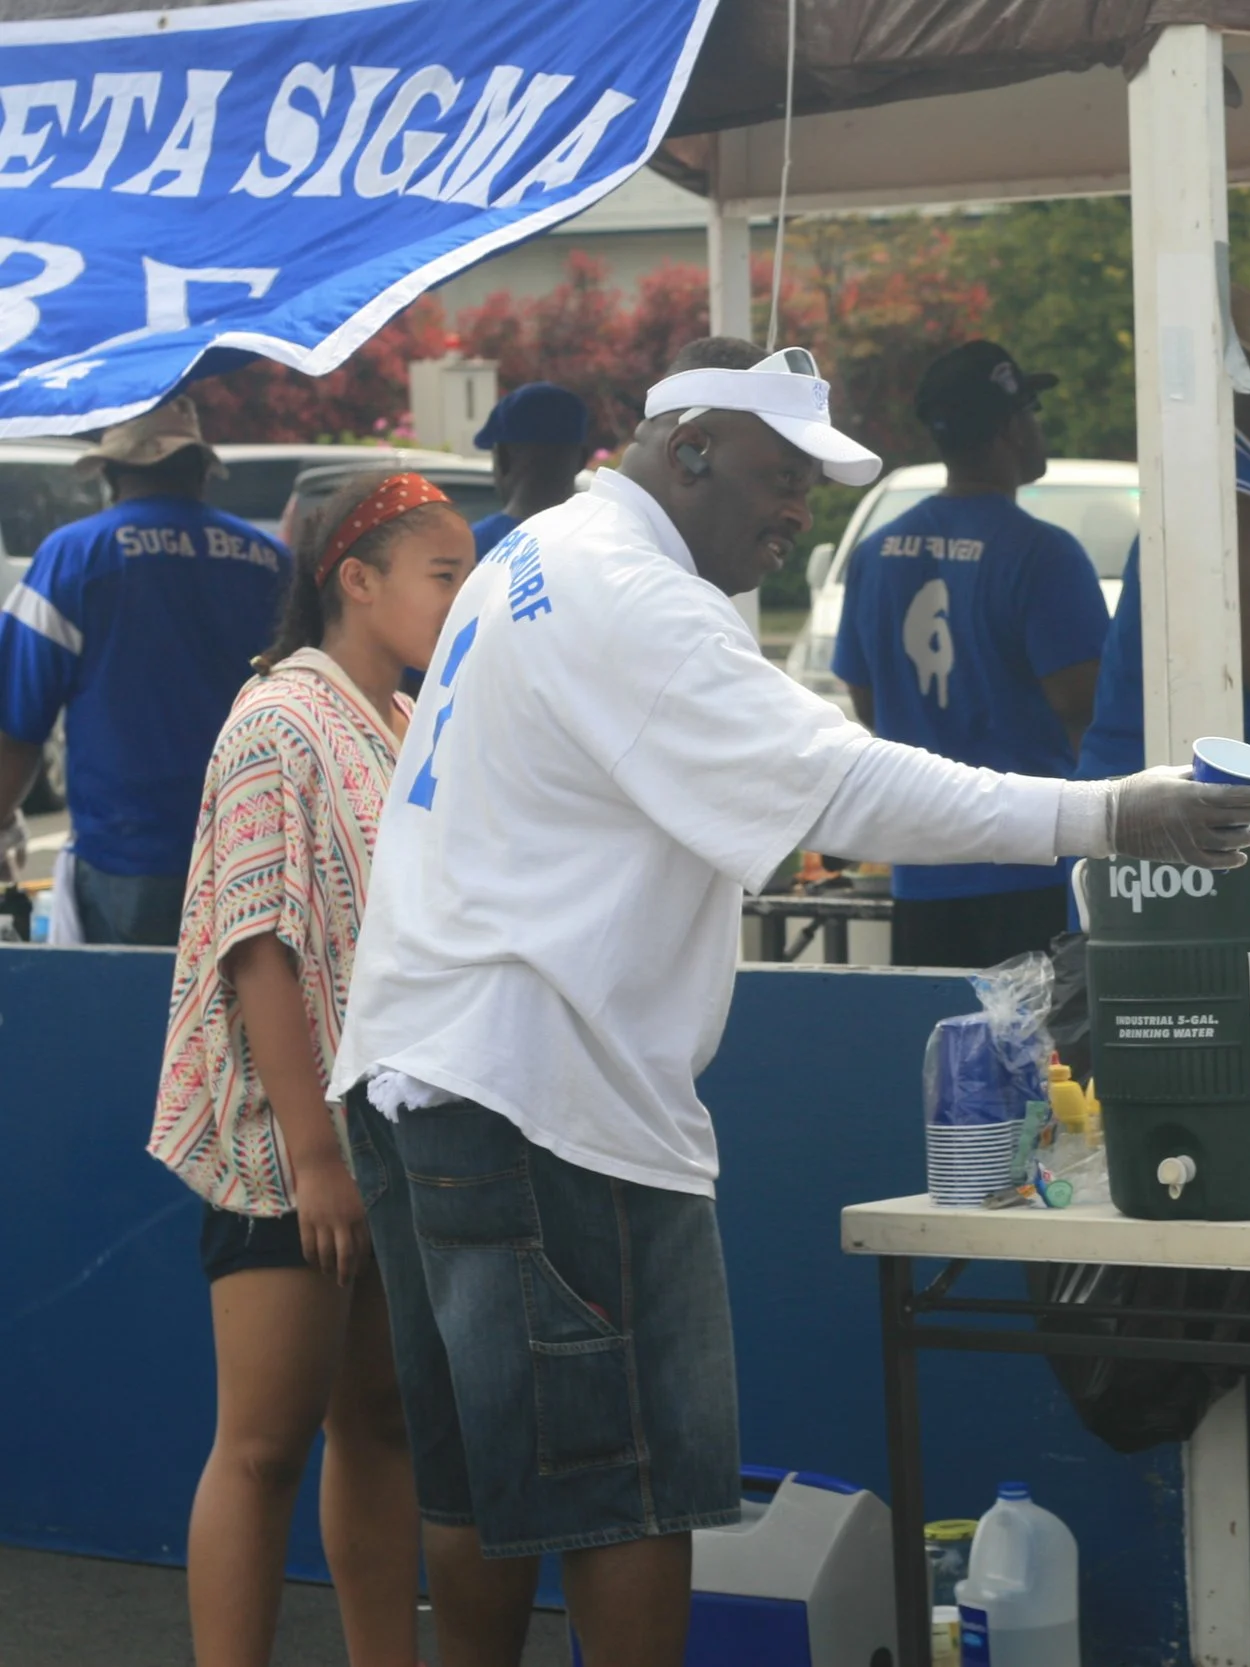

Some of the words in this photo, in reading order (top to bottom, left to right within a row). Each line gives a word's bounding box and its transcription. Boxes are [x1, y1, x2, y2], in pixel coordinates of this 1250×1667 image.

[229, 62, 636, 209] SIGMA
[116, 526, 196, 557] SUGA
[203, 527, 279, 573] BEAR
[1109, 854, 1214, 913] igloo
[1115, 1015, 1174, 1026] INDUSTRIAL
[1177, 1014, 1219, 1025] 5-GAL.
[1119, 1028, 1170, 1039] DRINKING
[1173, 1027, 1215, 1038] WATER
